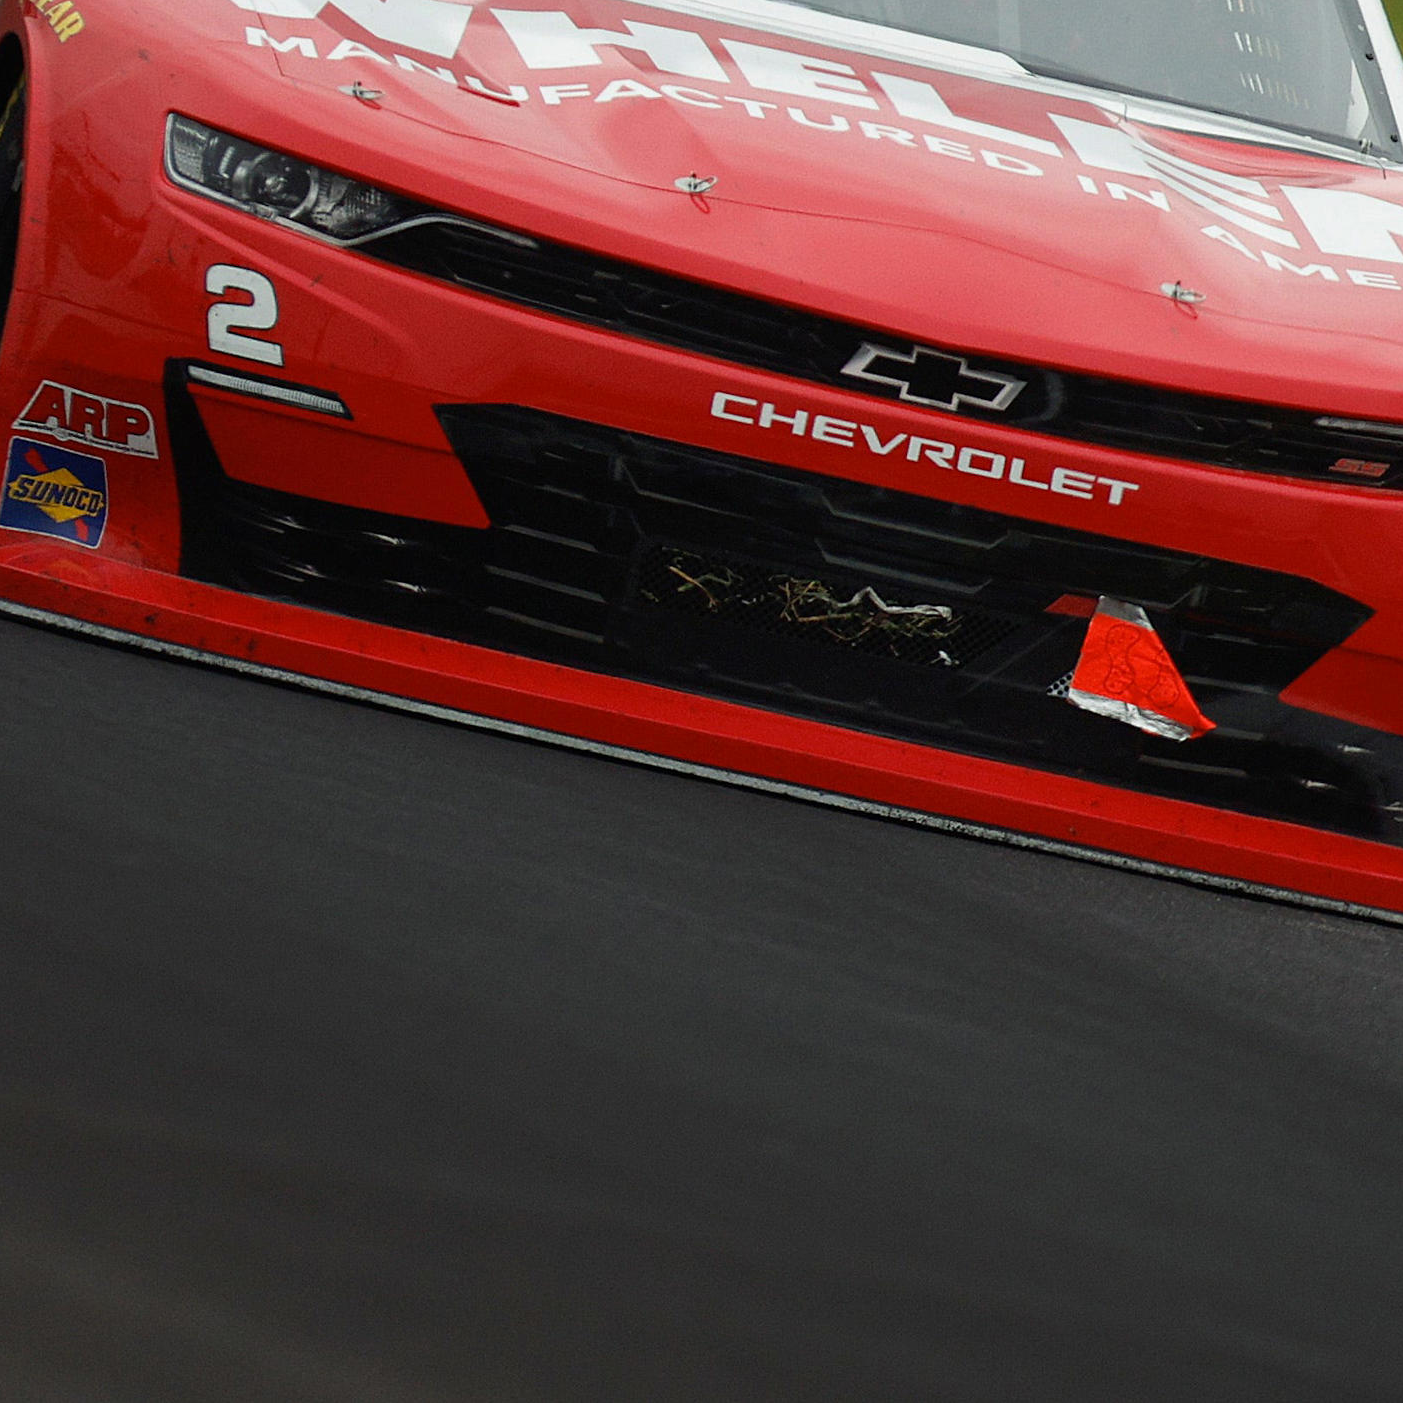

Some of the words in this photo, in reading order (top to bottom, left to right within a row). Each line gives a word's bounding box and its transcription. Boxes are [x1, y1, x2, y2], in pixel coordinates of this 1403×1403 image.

[245, 26, 1044, 179] MANUFACTURED
[1077, 174, 1169, 214] IN
[204, 263, 284, 367] 2
[18, 383, 151, 446] ARP
[709, 391, 1141, 508] CHEVROLET
[13, 477, 104, 514] SUNOCO
